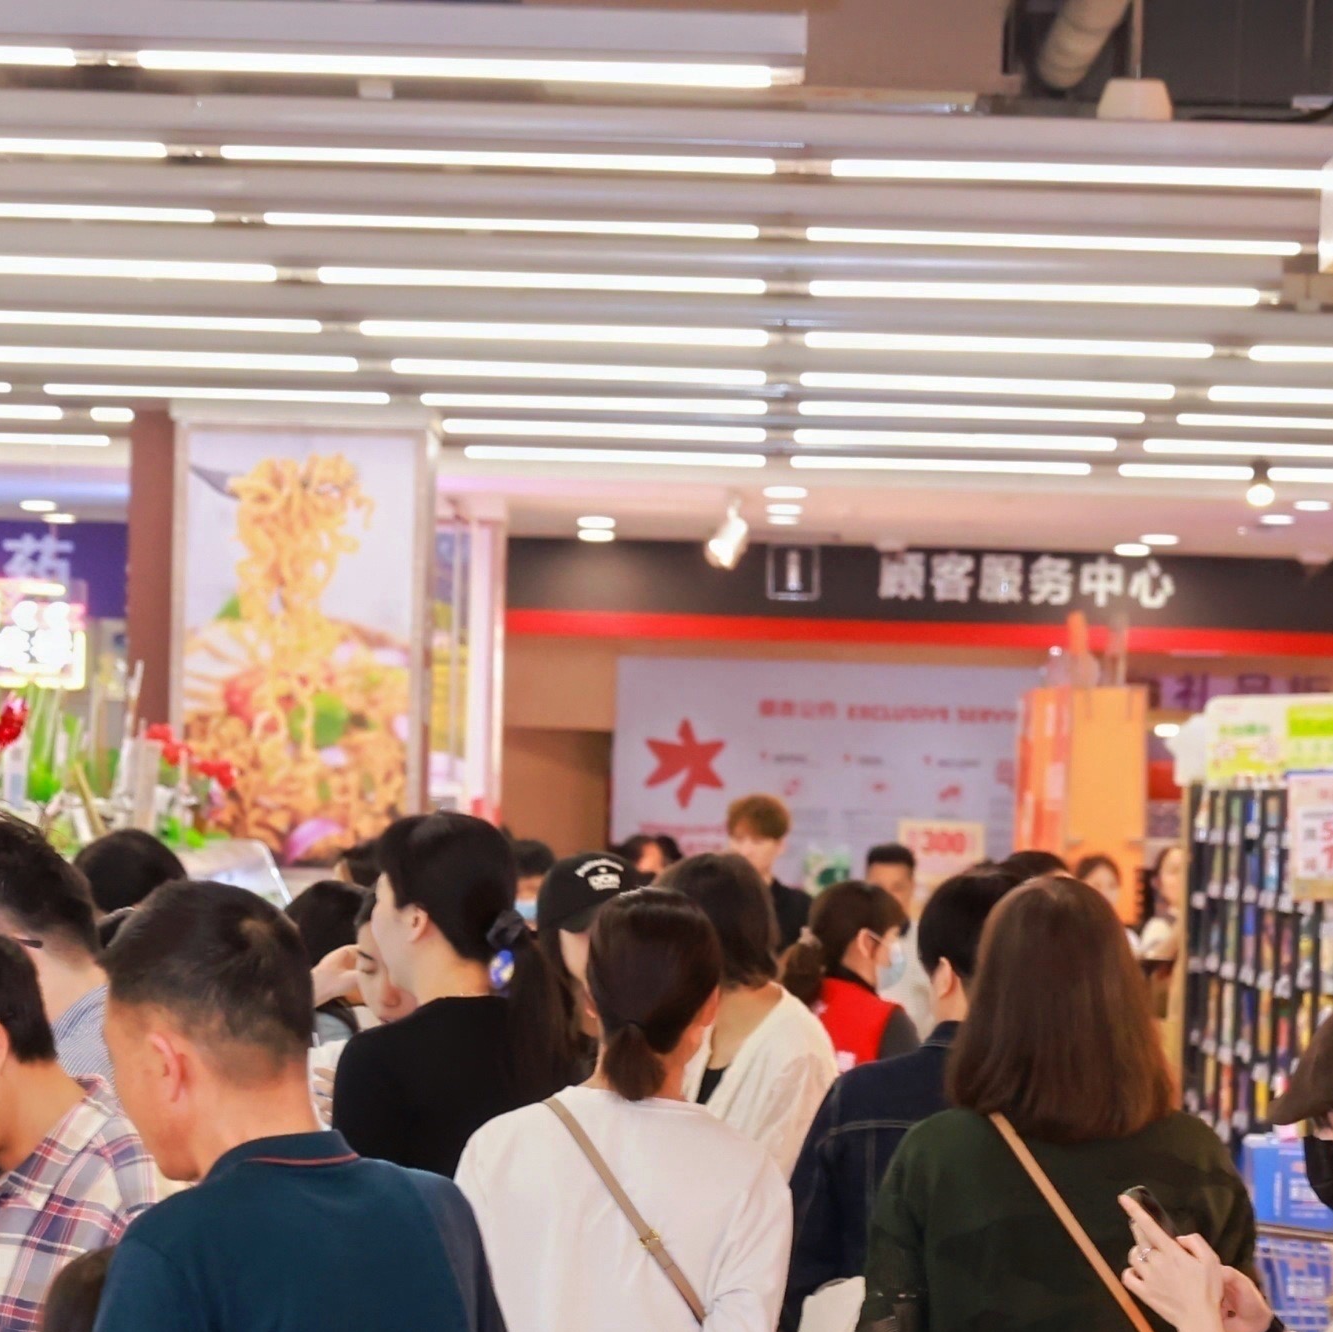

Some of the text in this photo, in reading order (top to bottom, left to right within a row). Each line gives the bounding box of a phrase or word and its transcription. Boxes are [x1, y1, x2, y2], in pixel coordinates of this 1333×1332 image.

[879, 552, 1175, 609] 顾客服务中心
